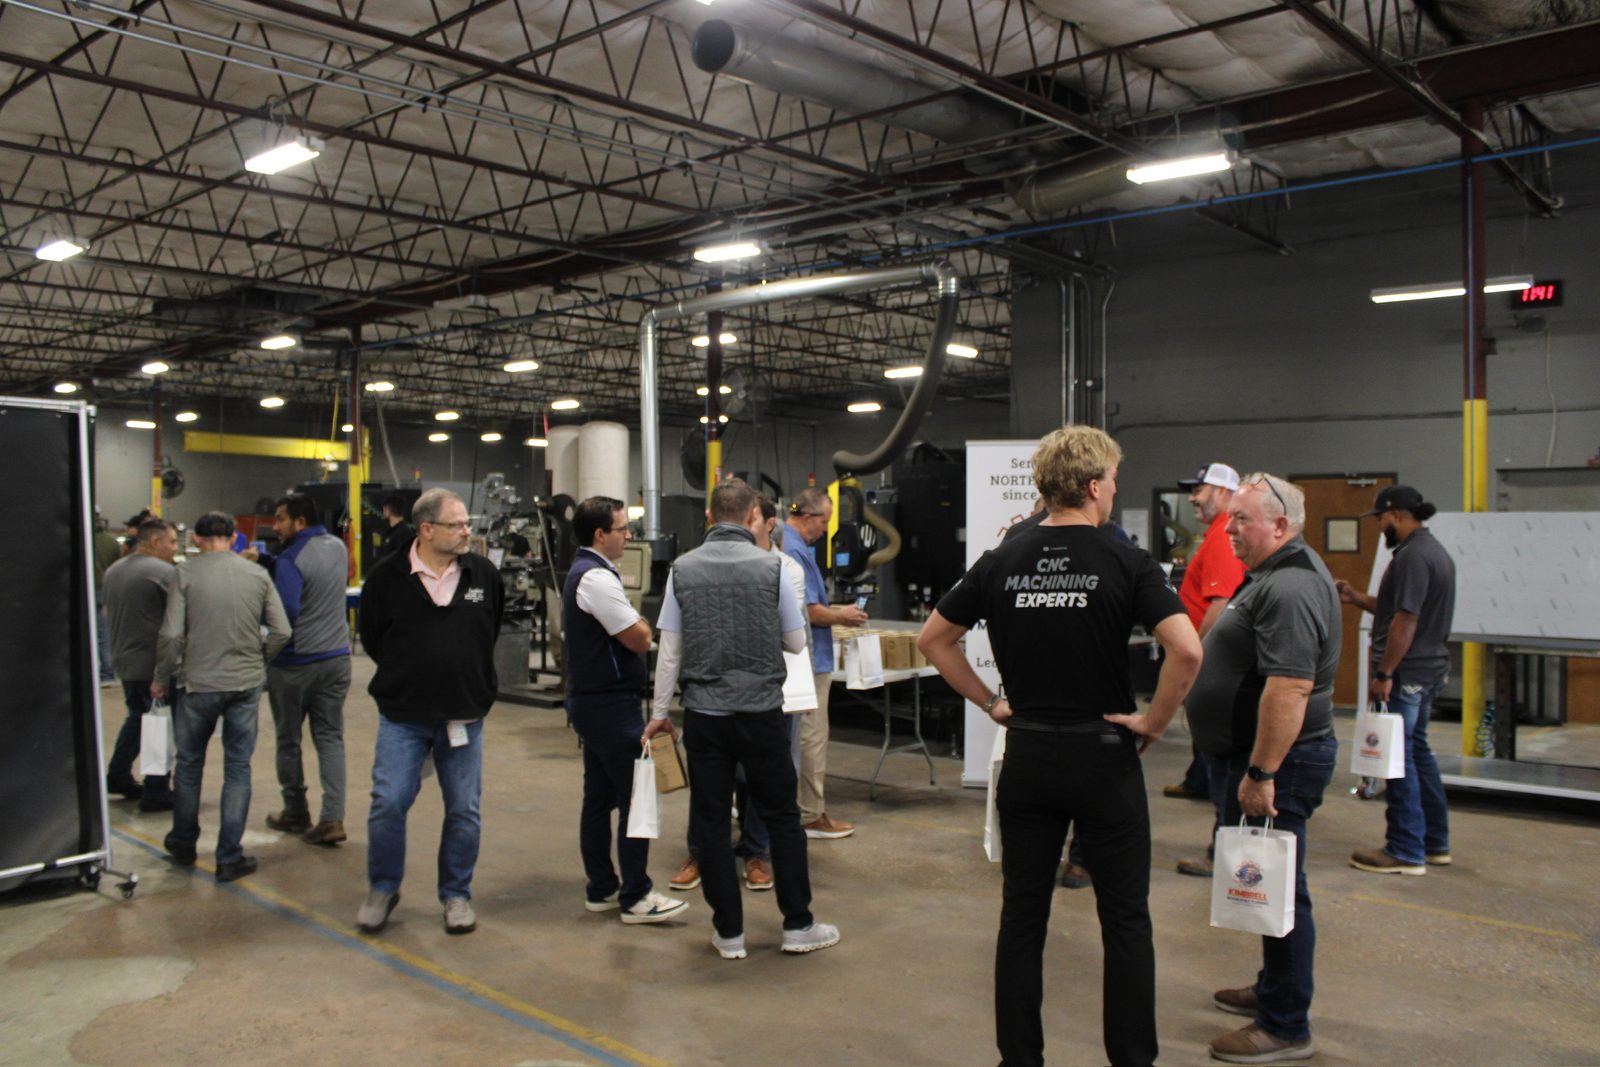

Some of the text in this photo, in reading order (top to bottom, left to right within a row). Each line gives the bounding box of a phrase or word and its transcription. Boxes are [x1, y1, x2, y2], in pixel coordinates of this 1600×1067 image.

[1002, 489, 1037, 501] since
[1036, 557, 1070, 572] CNC
[1004, 574, 1099, 591] MACHINING
[1015, 592, 1088, 608] EXPERTS
